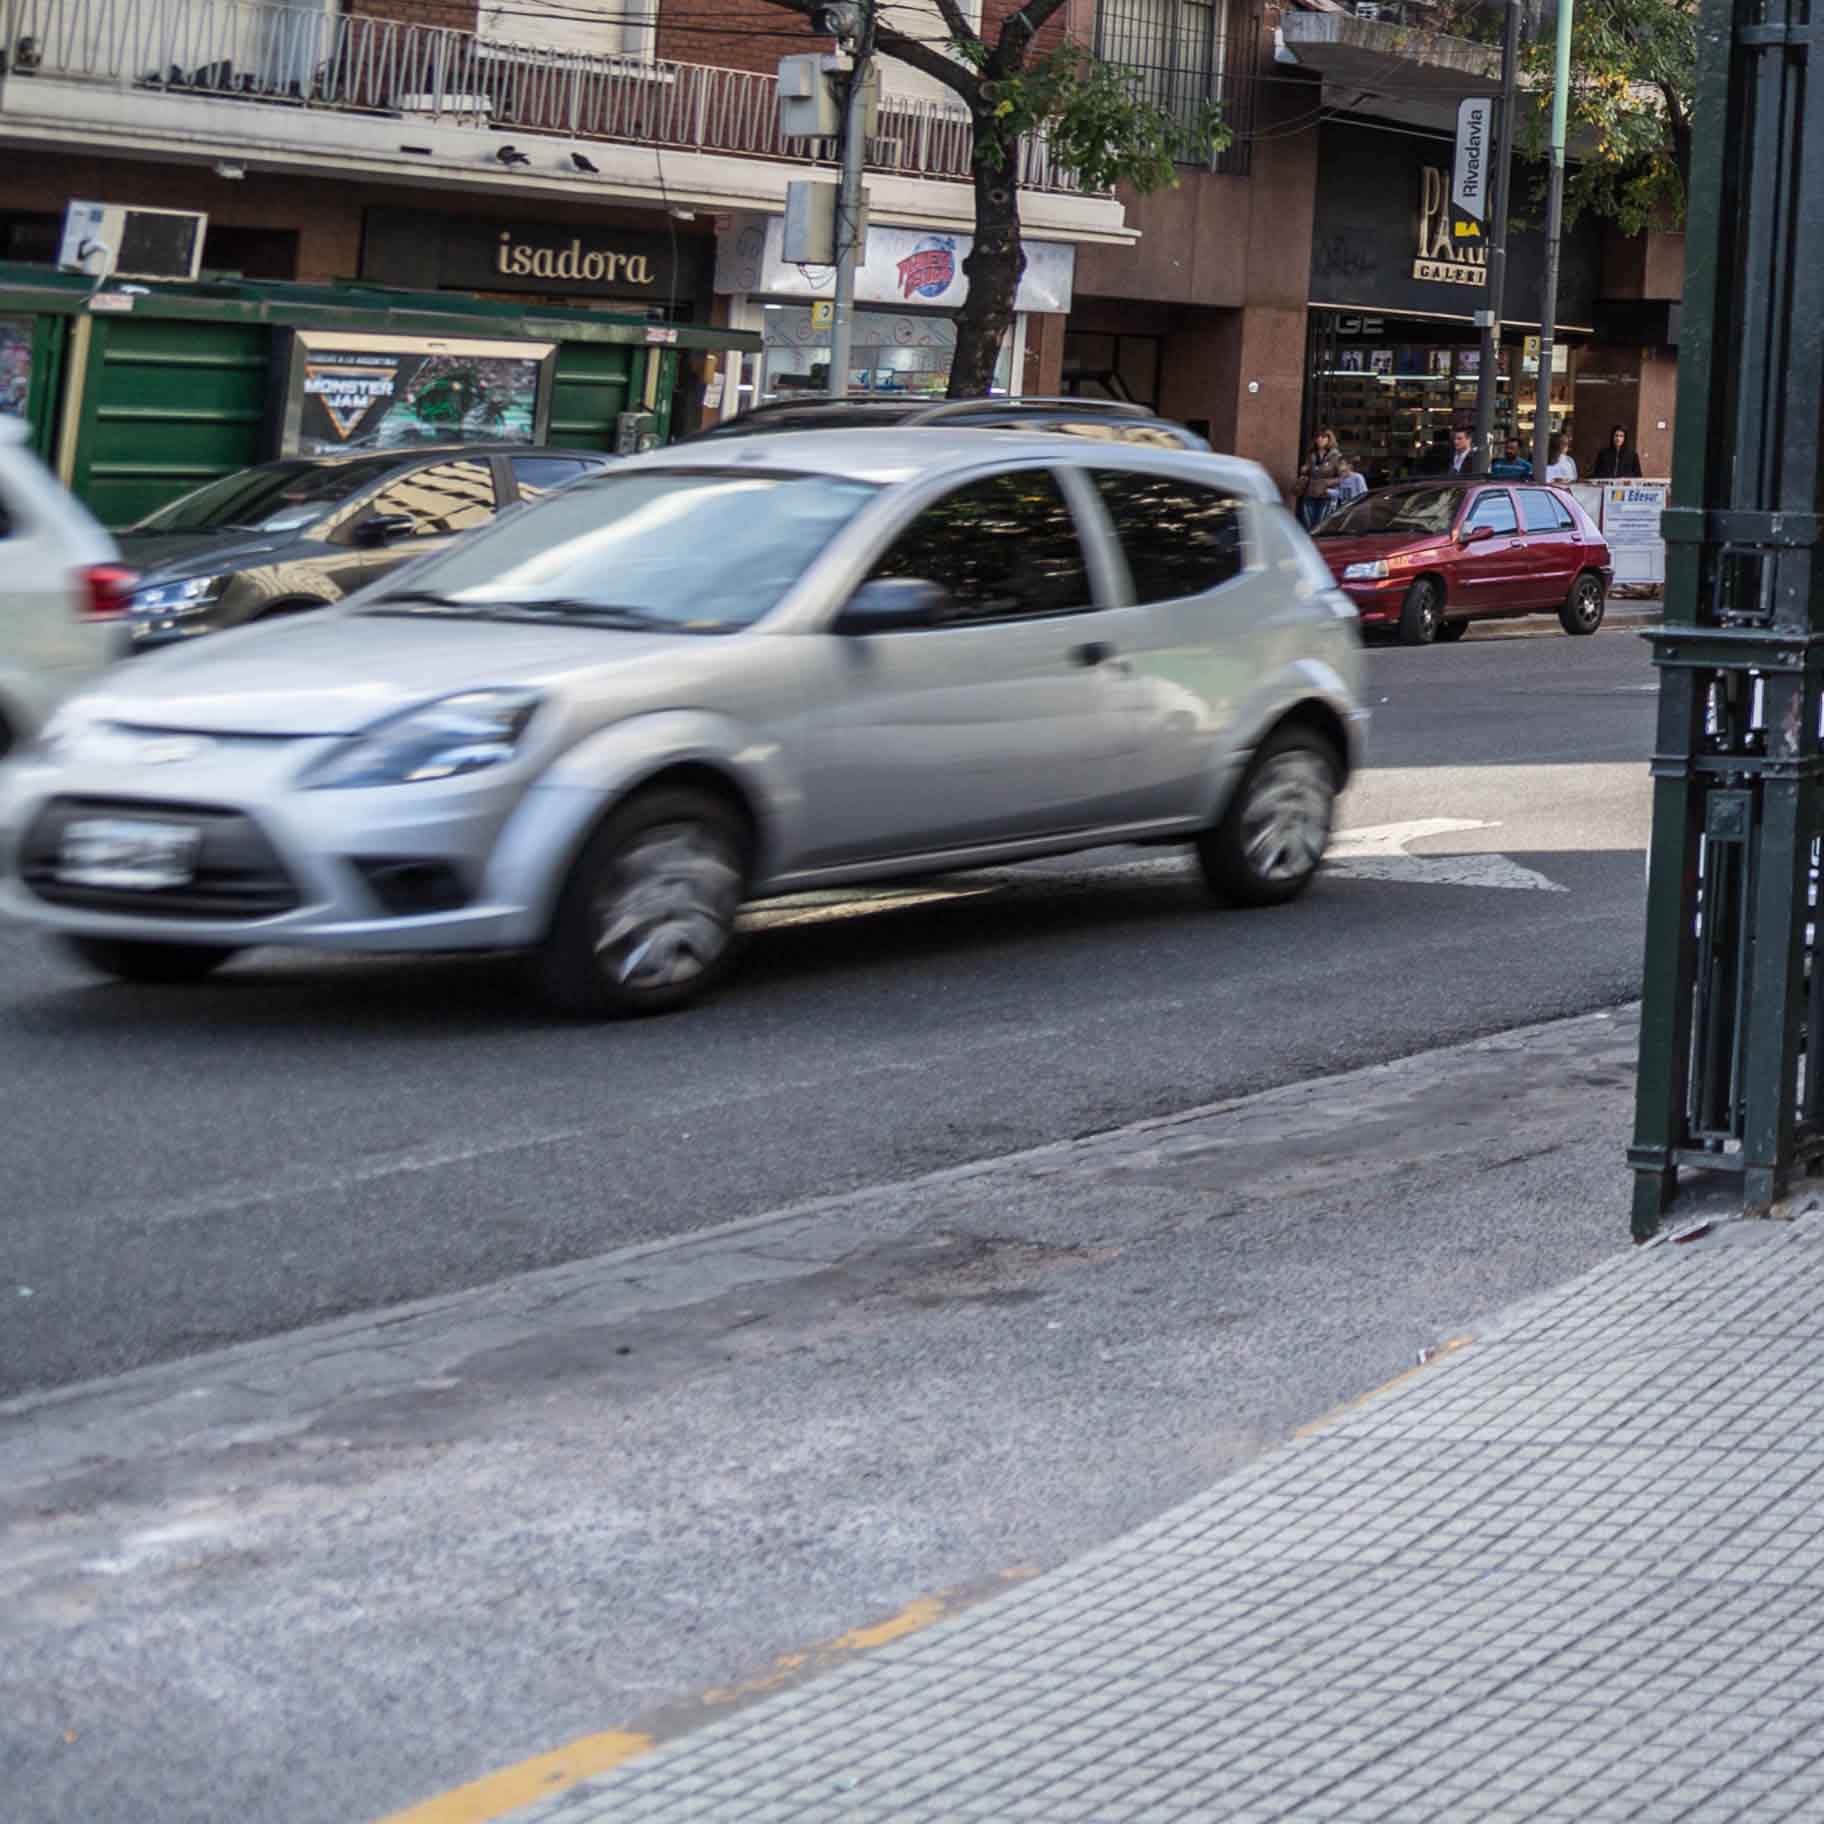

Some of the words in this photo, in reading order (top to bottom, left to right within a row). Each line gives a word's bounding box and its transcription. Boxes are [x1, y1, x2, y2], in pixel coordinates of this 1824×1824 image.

[1462, 109, 1484, 198] Rivadavia
[499, 232, 656, 283] isadora
[304, 378, 395, 396] MONSTER
[328, 393, 369, 408] JAM
